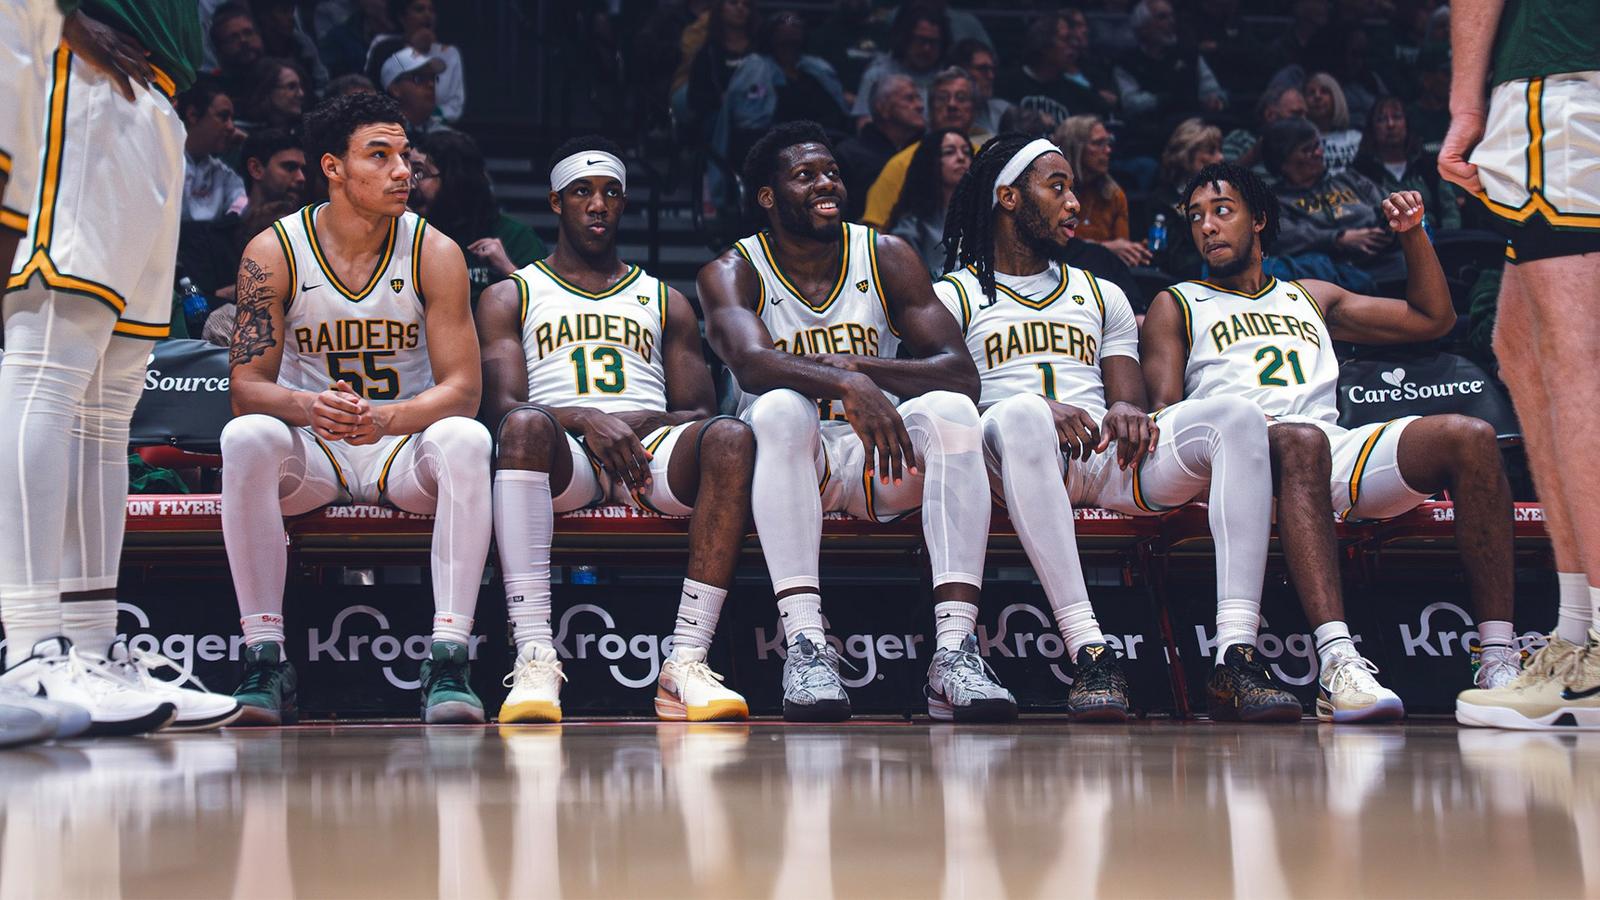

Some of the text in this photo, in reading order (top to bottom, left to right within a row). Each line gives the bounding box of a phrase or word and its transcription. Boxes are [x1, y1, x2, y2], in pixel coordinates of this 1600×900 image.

[294, 319, 419, 352] RAIDERS
[535, 313, 656, 364] RAIDERS
[984, 321, 1098, 370] RAIDERS
[1210, 312, 1321, 353] RAIDERS
[326, 350, 400, 401] 55
[569, 344, 627, 396] 13
[1033, 361, 1061, 402] 1
[1253, 345, 1307, 388] 21
[1348, 380, 1484, 404] CareSource
[127, 501, 154, 516] ON
[977, 603, 1144, 686] Kroer
